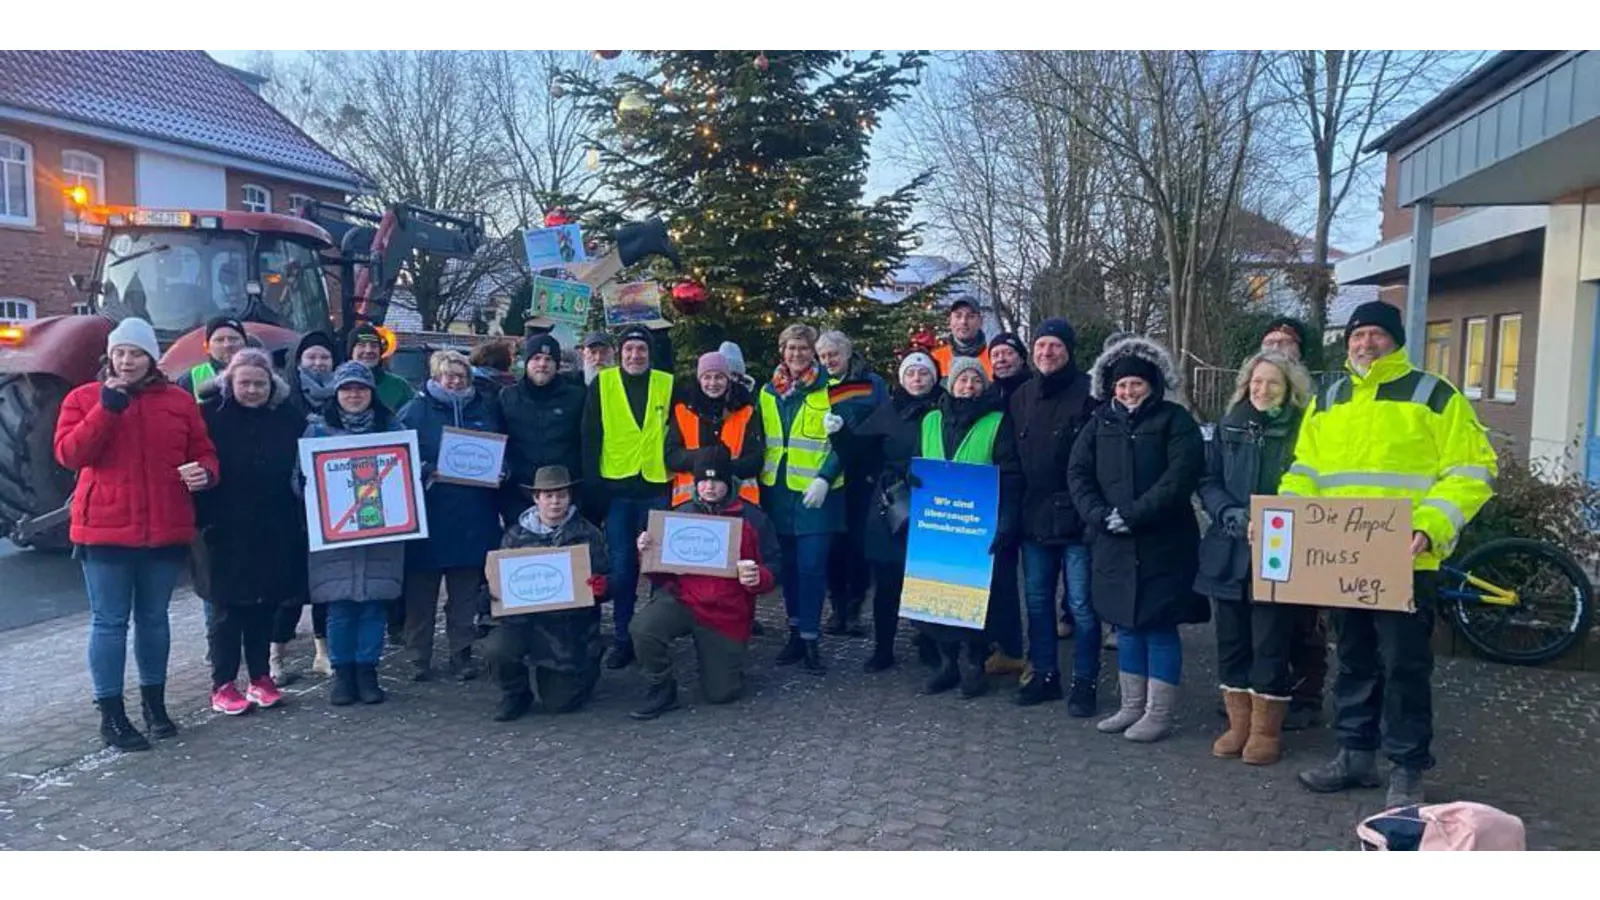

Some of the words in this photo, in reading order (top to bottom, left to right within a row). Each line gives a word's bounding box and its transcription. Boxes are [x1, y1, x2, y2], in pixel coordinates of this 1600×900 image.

[933, 495, 951, 506] Wir
[952, 499, 975, 509] sind
[1304, 503, 1339, 525] Die
[1344, 506, 1397, 542] Ampel
